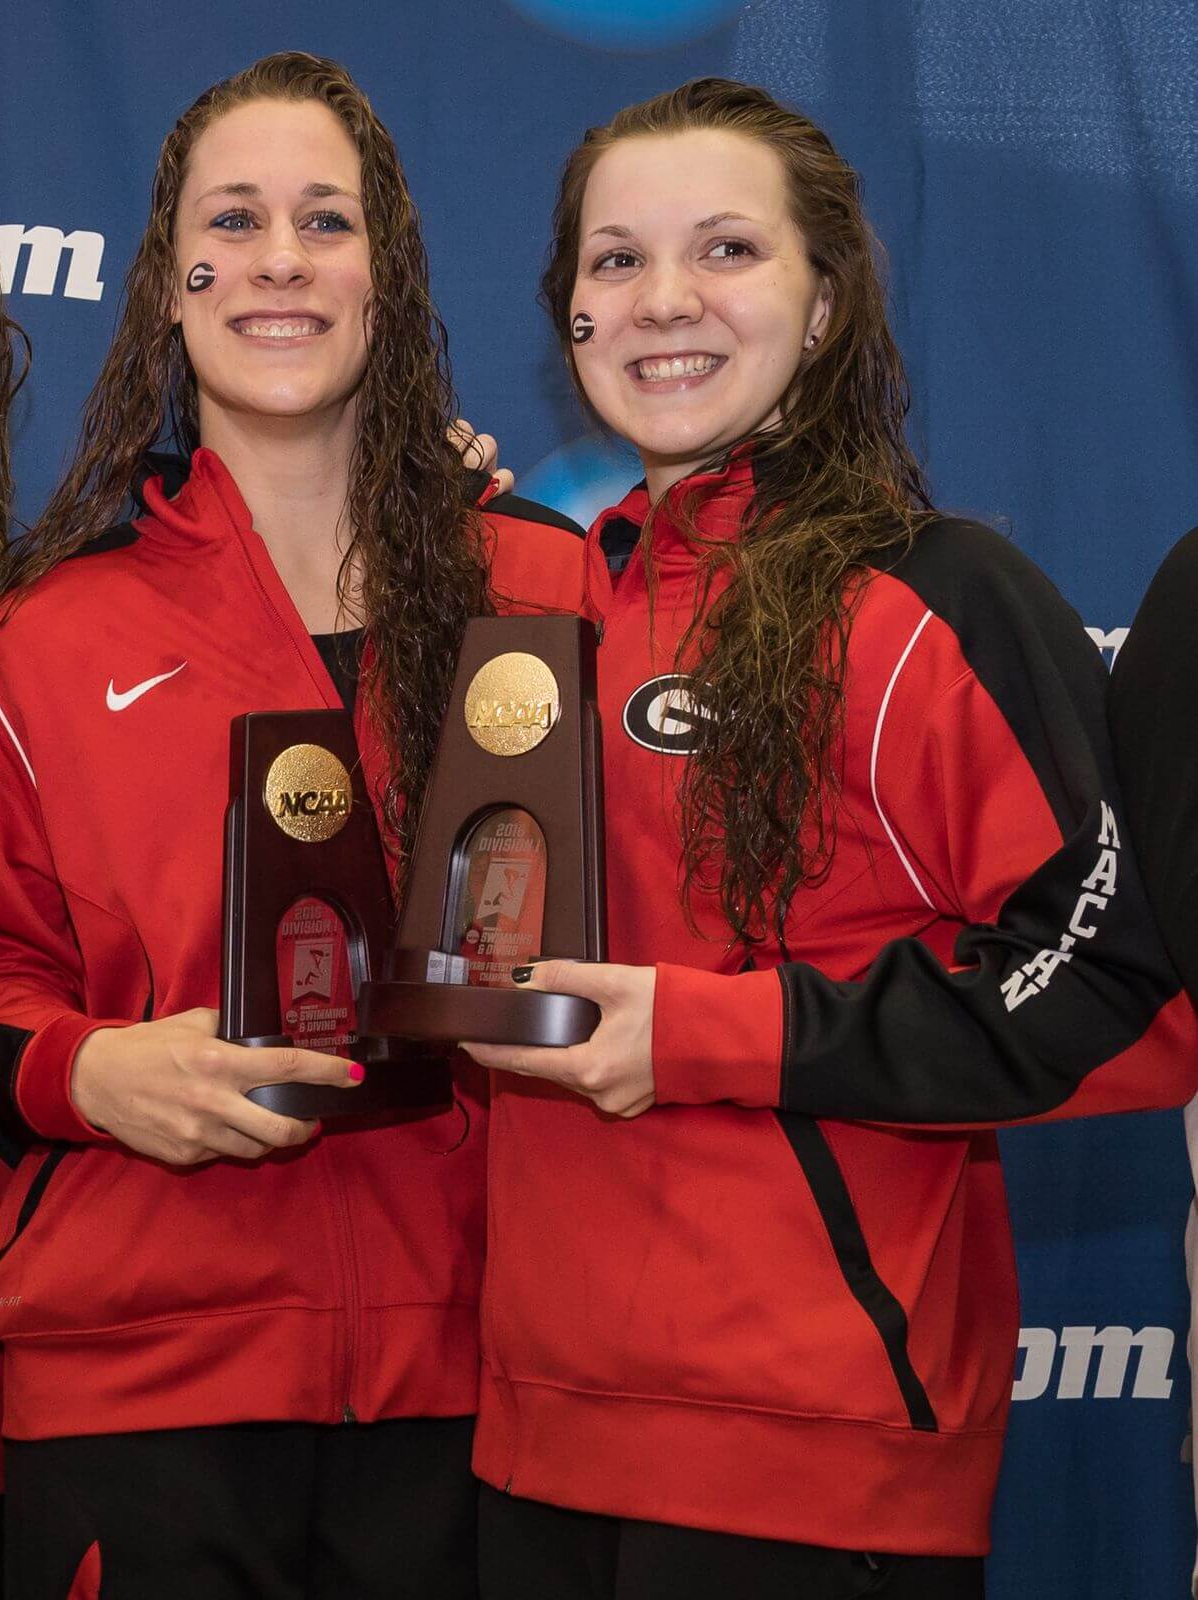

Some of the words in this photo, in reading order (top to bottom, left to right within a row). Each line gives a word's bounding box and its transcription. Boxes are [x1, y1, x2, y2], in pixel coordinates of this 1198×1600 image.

[275, 789, 348, 817] NCAA
[479, 837, 534, 852] DIVISION
[282, 919, 333, 937] DIVISION
[300, 1007, 348, 1022] SWIMMING
